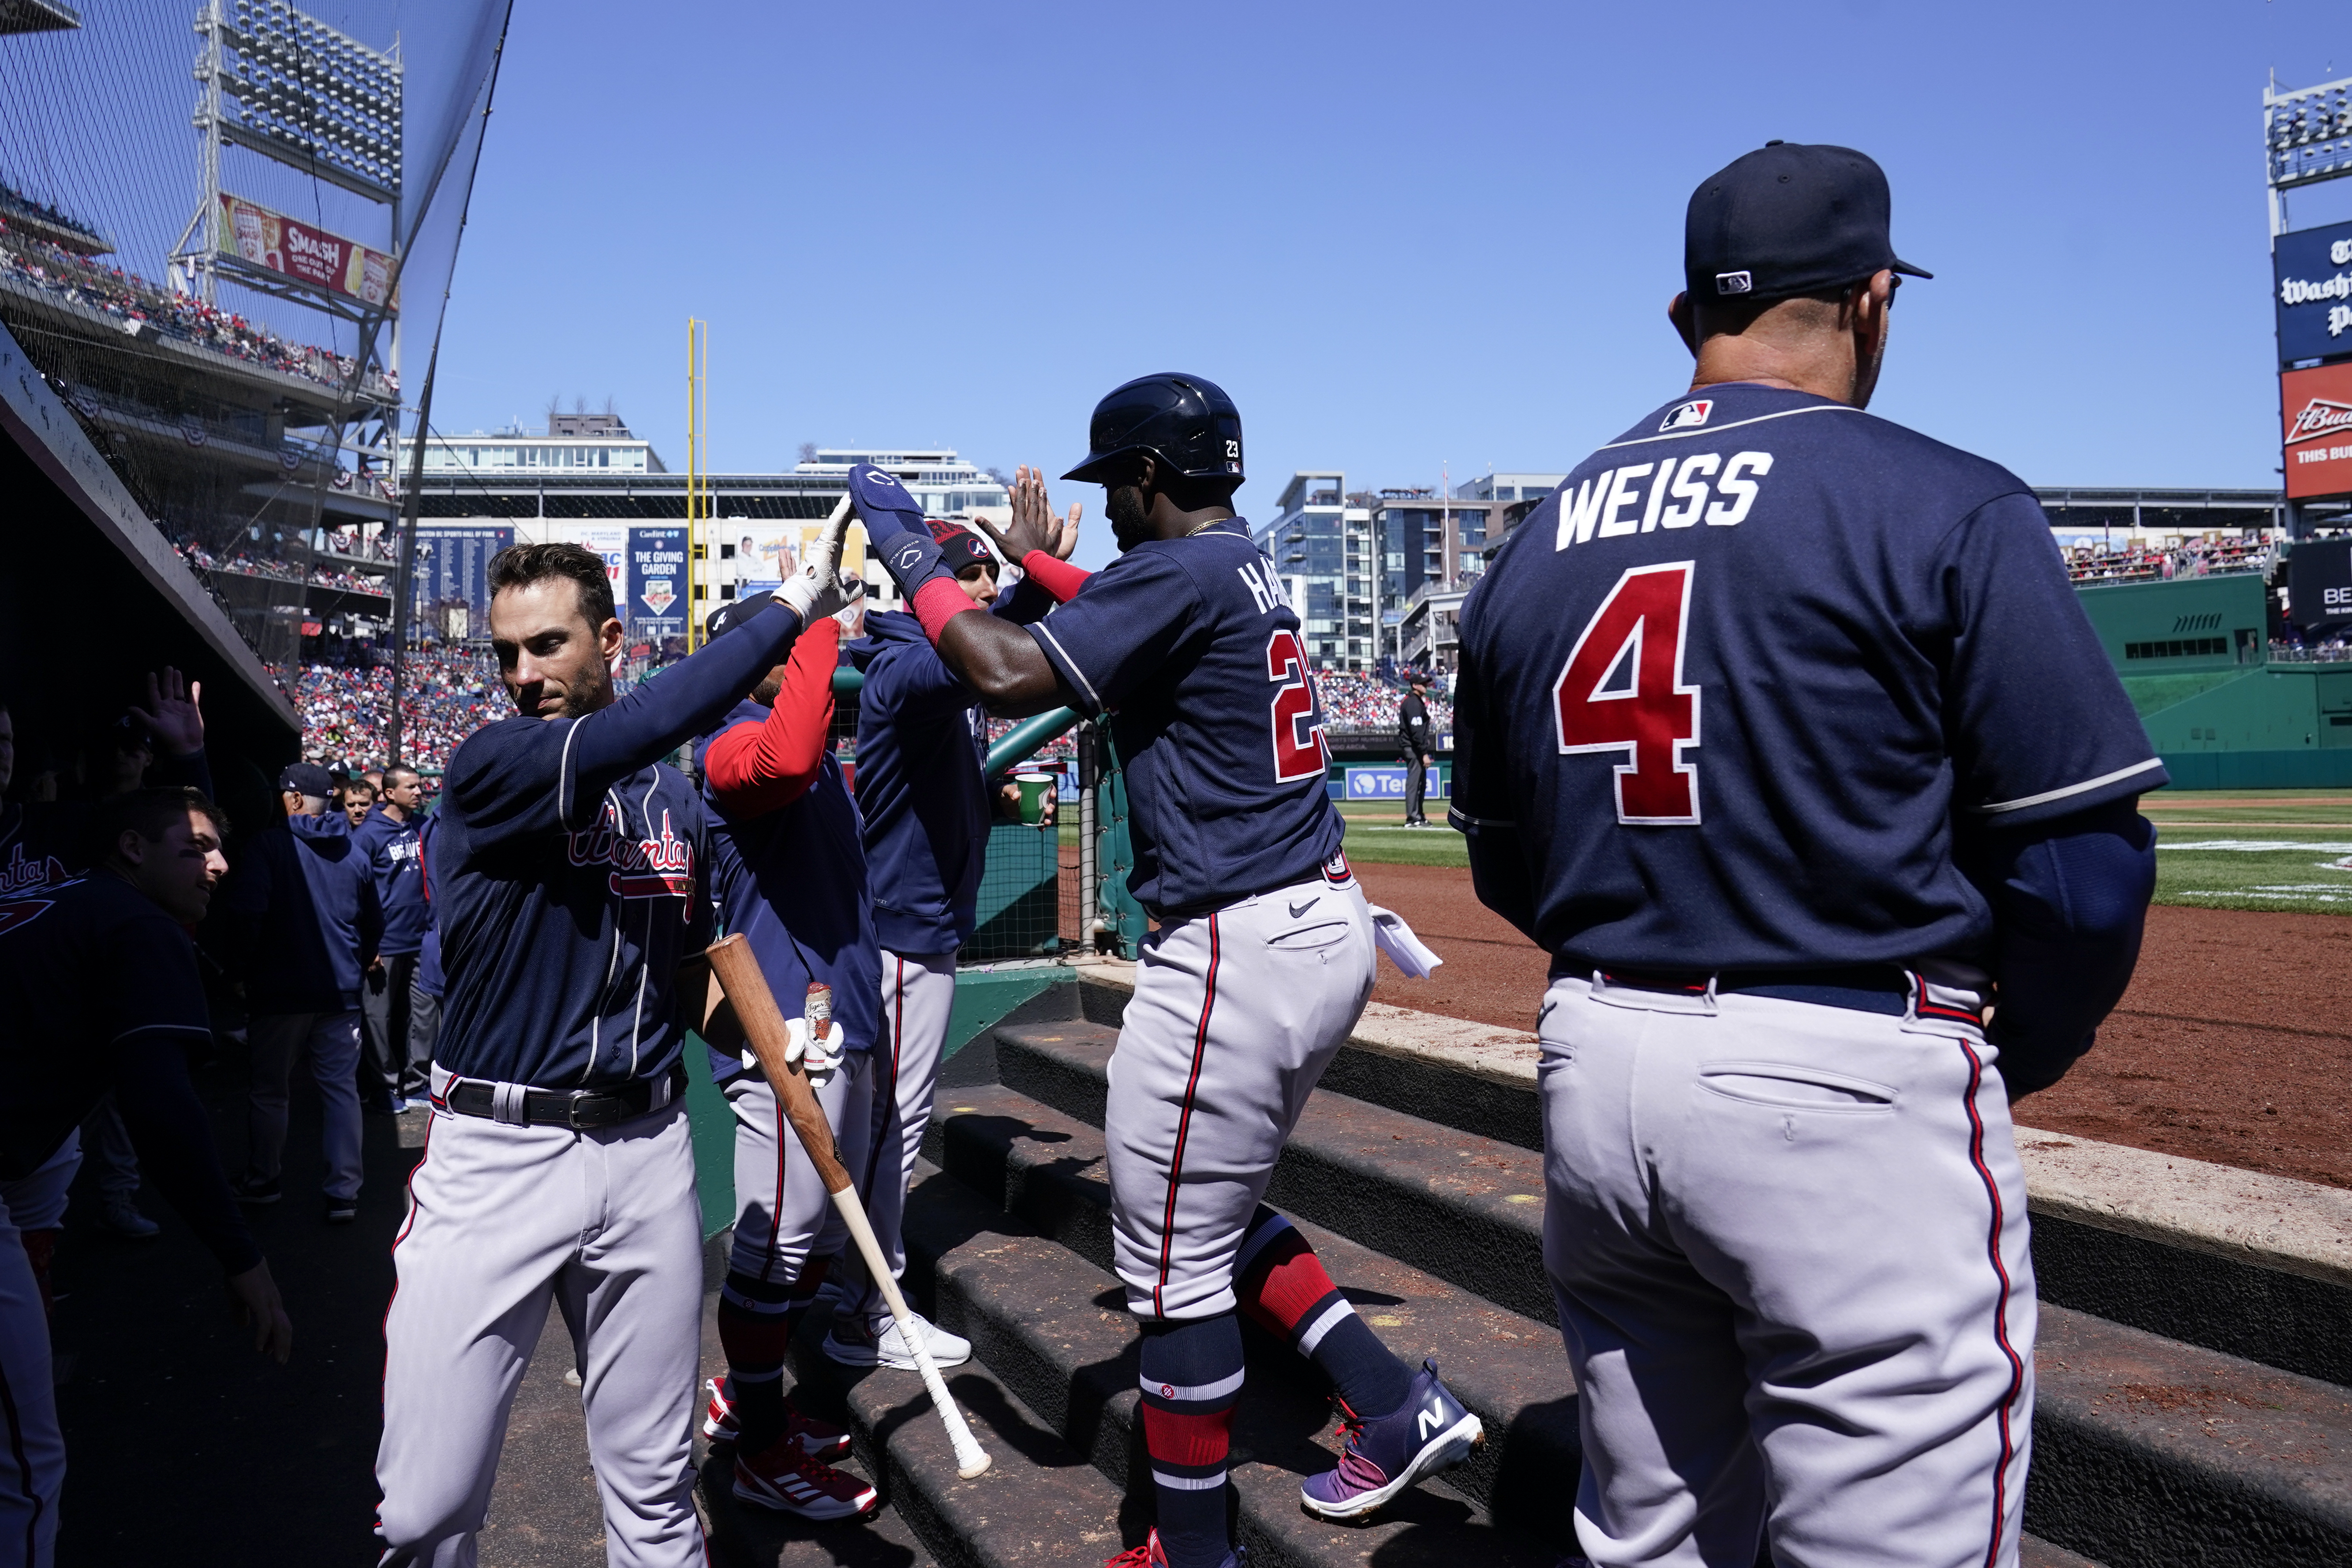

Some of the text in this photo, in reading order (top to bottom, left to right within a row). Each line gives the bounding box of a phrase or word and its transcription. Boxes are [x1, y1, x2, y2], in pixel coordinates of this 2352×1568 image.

[288, 226, 340, 269] SMASH
[2296, 406, 2352, 430] Bud
[1226, 440, 1239, 458] 23
[2296, 448, 2328, 464] THIS
[1556, 451, 1774, 552] WEISS
[601, 553, 621, 565] AC
[635, 551, 684, 563] THE GIVING
[890, 540, 920, 564] EVOSHIELD
[641, 564, 677, 575] GARDEN
[2324, 587, 2352, 605] BE
[1552, 560, 1701, 825] 4
[1411, 716, 1423, 726] 43
[568, 801, 686, 871] tlanta
[389, 841, 420, 861] BRAVE
[0, 842, 45, 892] nta
[807, 1002, 825, 1013] Tiger
[1417, 1396, 1445, 1441] N
